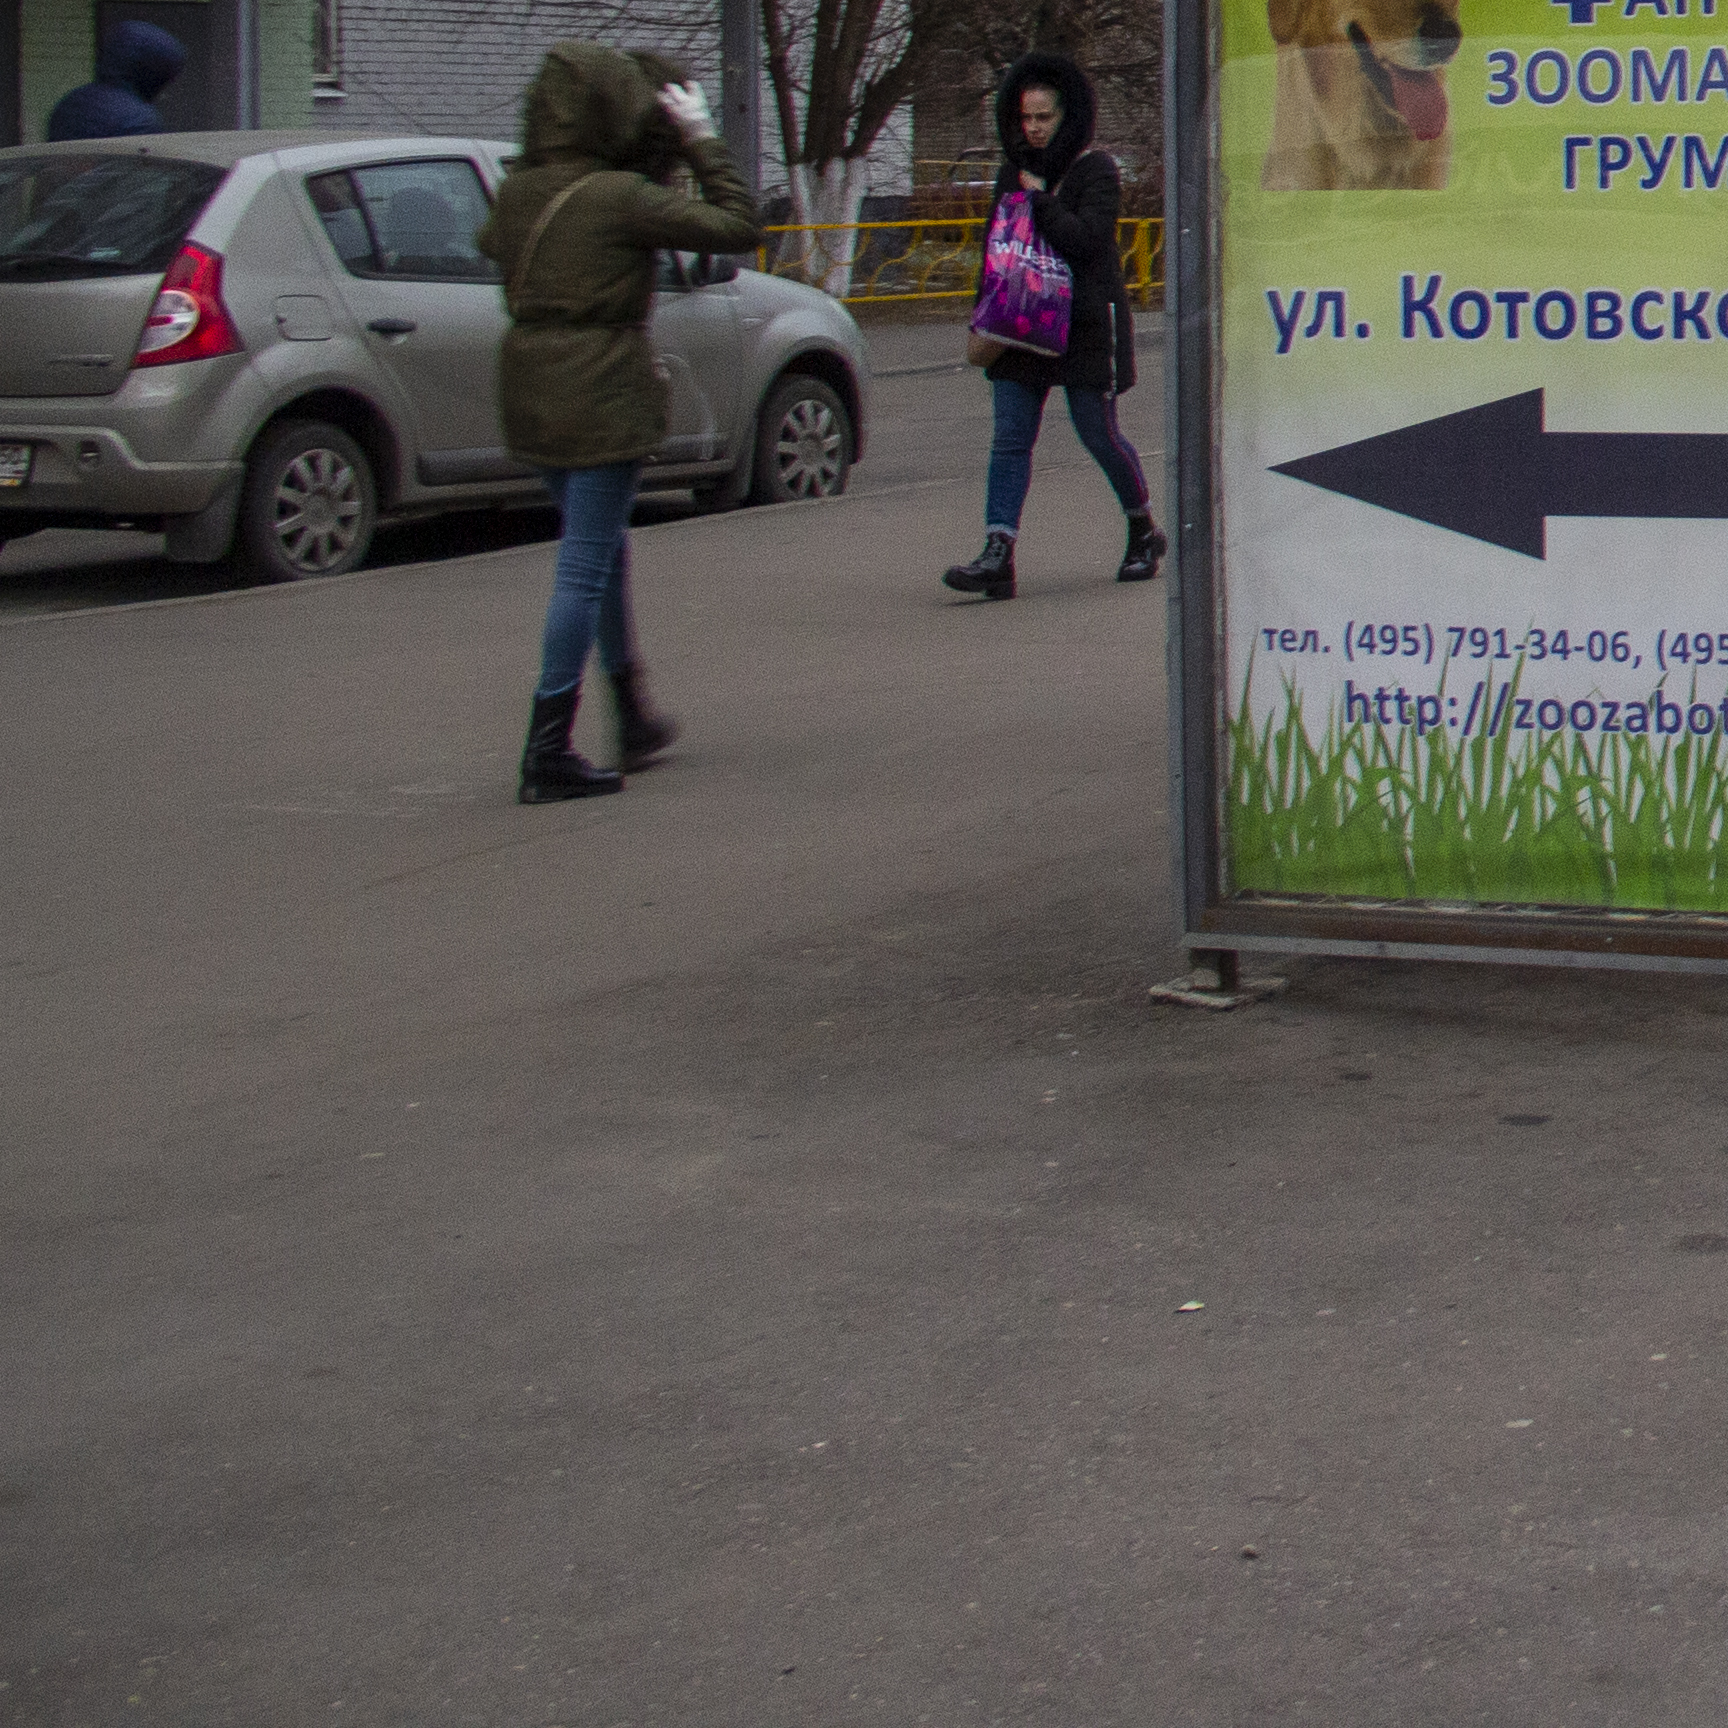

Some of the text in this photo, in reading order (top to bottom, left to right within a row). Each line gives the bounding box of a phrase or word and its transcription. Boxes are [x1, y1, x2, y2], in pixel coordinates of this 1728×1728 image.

[1265, 286, 1372, 354] ул.
[1261, 628, 1330, 653] тел.
[1345, 621, 1435, 664] (495)
[1447, 626, 1643, 668] 791-34-06,
